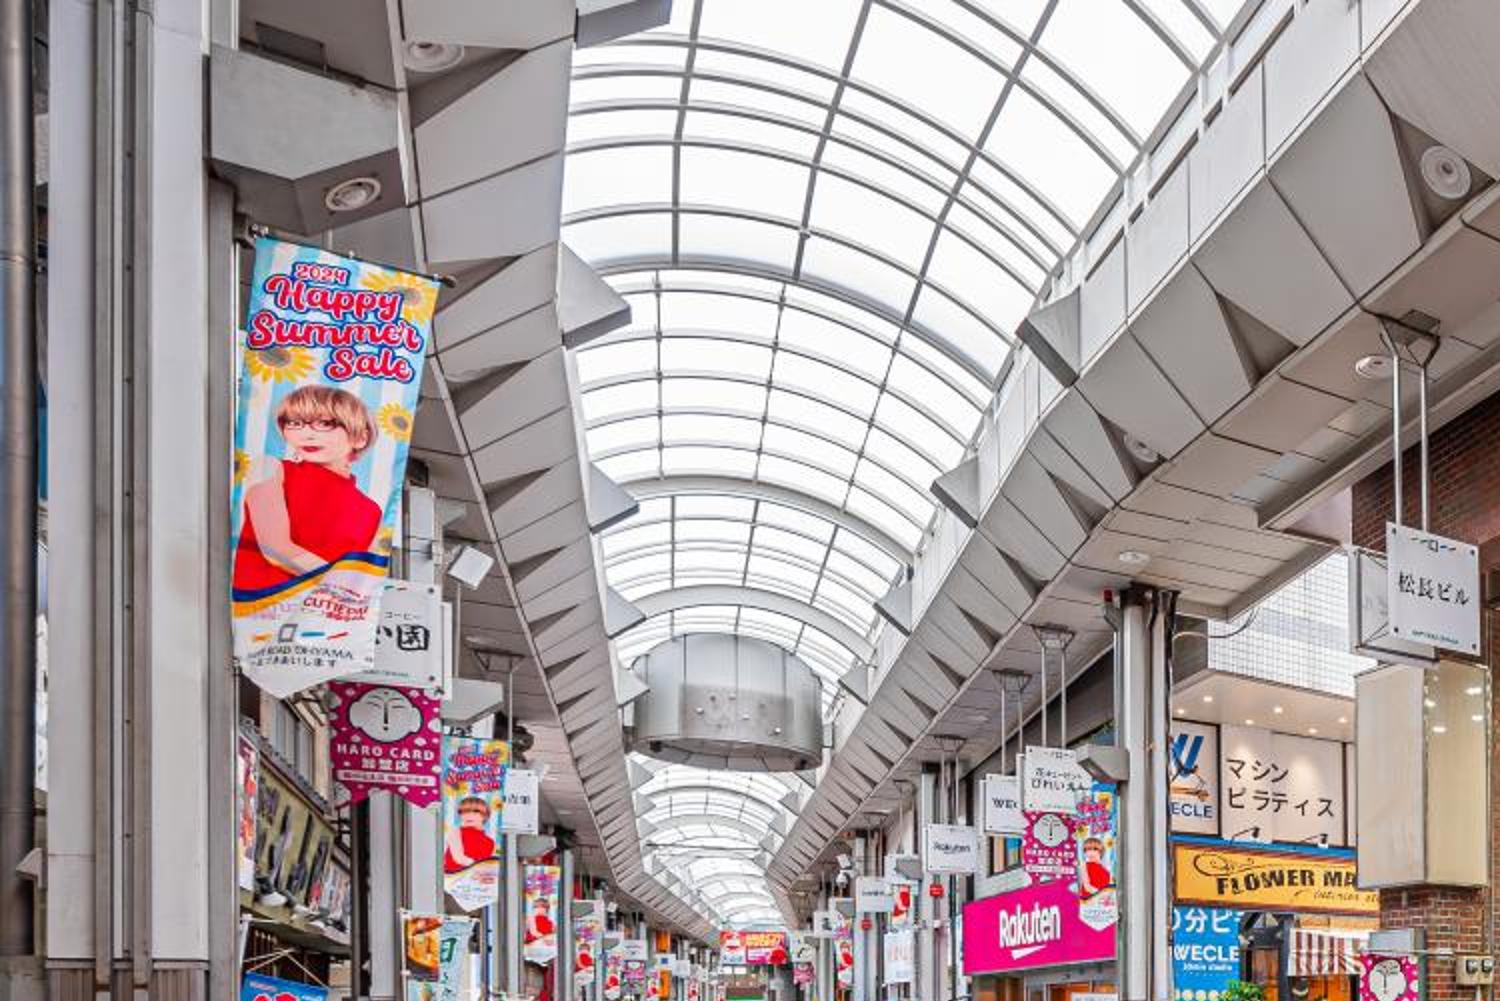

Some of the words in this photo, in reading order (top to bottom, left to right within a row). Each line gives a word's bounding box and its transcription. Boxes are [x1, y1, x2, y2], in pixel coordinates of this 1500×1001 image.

[295, 264, 348, 284] 2024
[265, 275, 402, 322] Happy
[249, 311, 422, 351] Summer
[327, 347, 413, 383] Sale
[1398, 571, 1470, 605] 松長ビル
[337, 743, 383, 757] HARO
[389, 747, 435, 762] CARD
[1227, 758, 1289, 783] マシン
[1171, 802, 1213, 818] ECLE
[1228, 787, 1335, 817] ピラティス
[1216, 869, 1315, 896] FLOWER
[1323, 871, 1358, 888] MA
[999, 902, 1061, 948] Rakuten
[1173, 944, 1239, 961] WECLE
